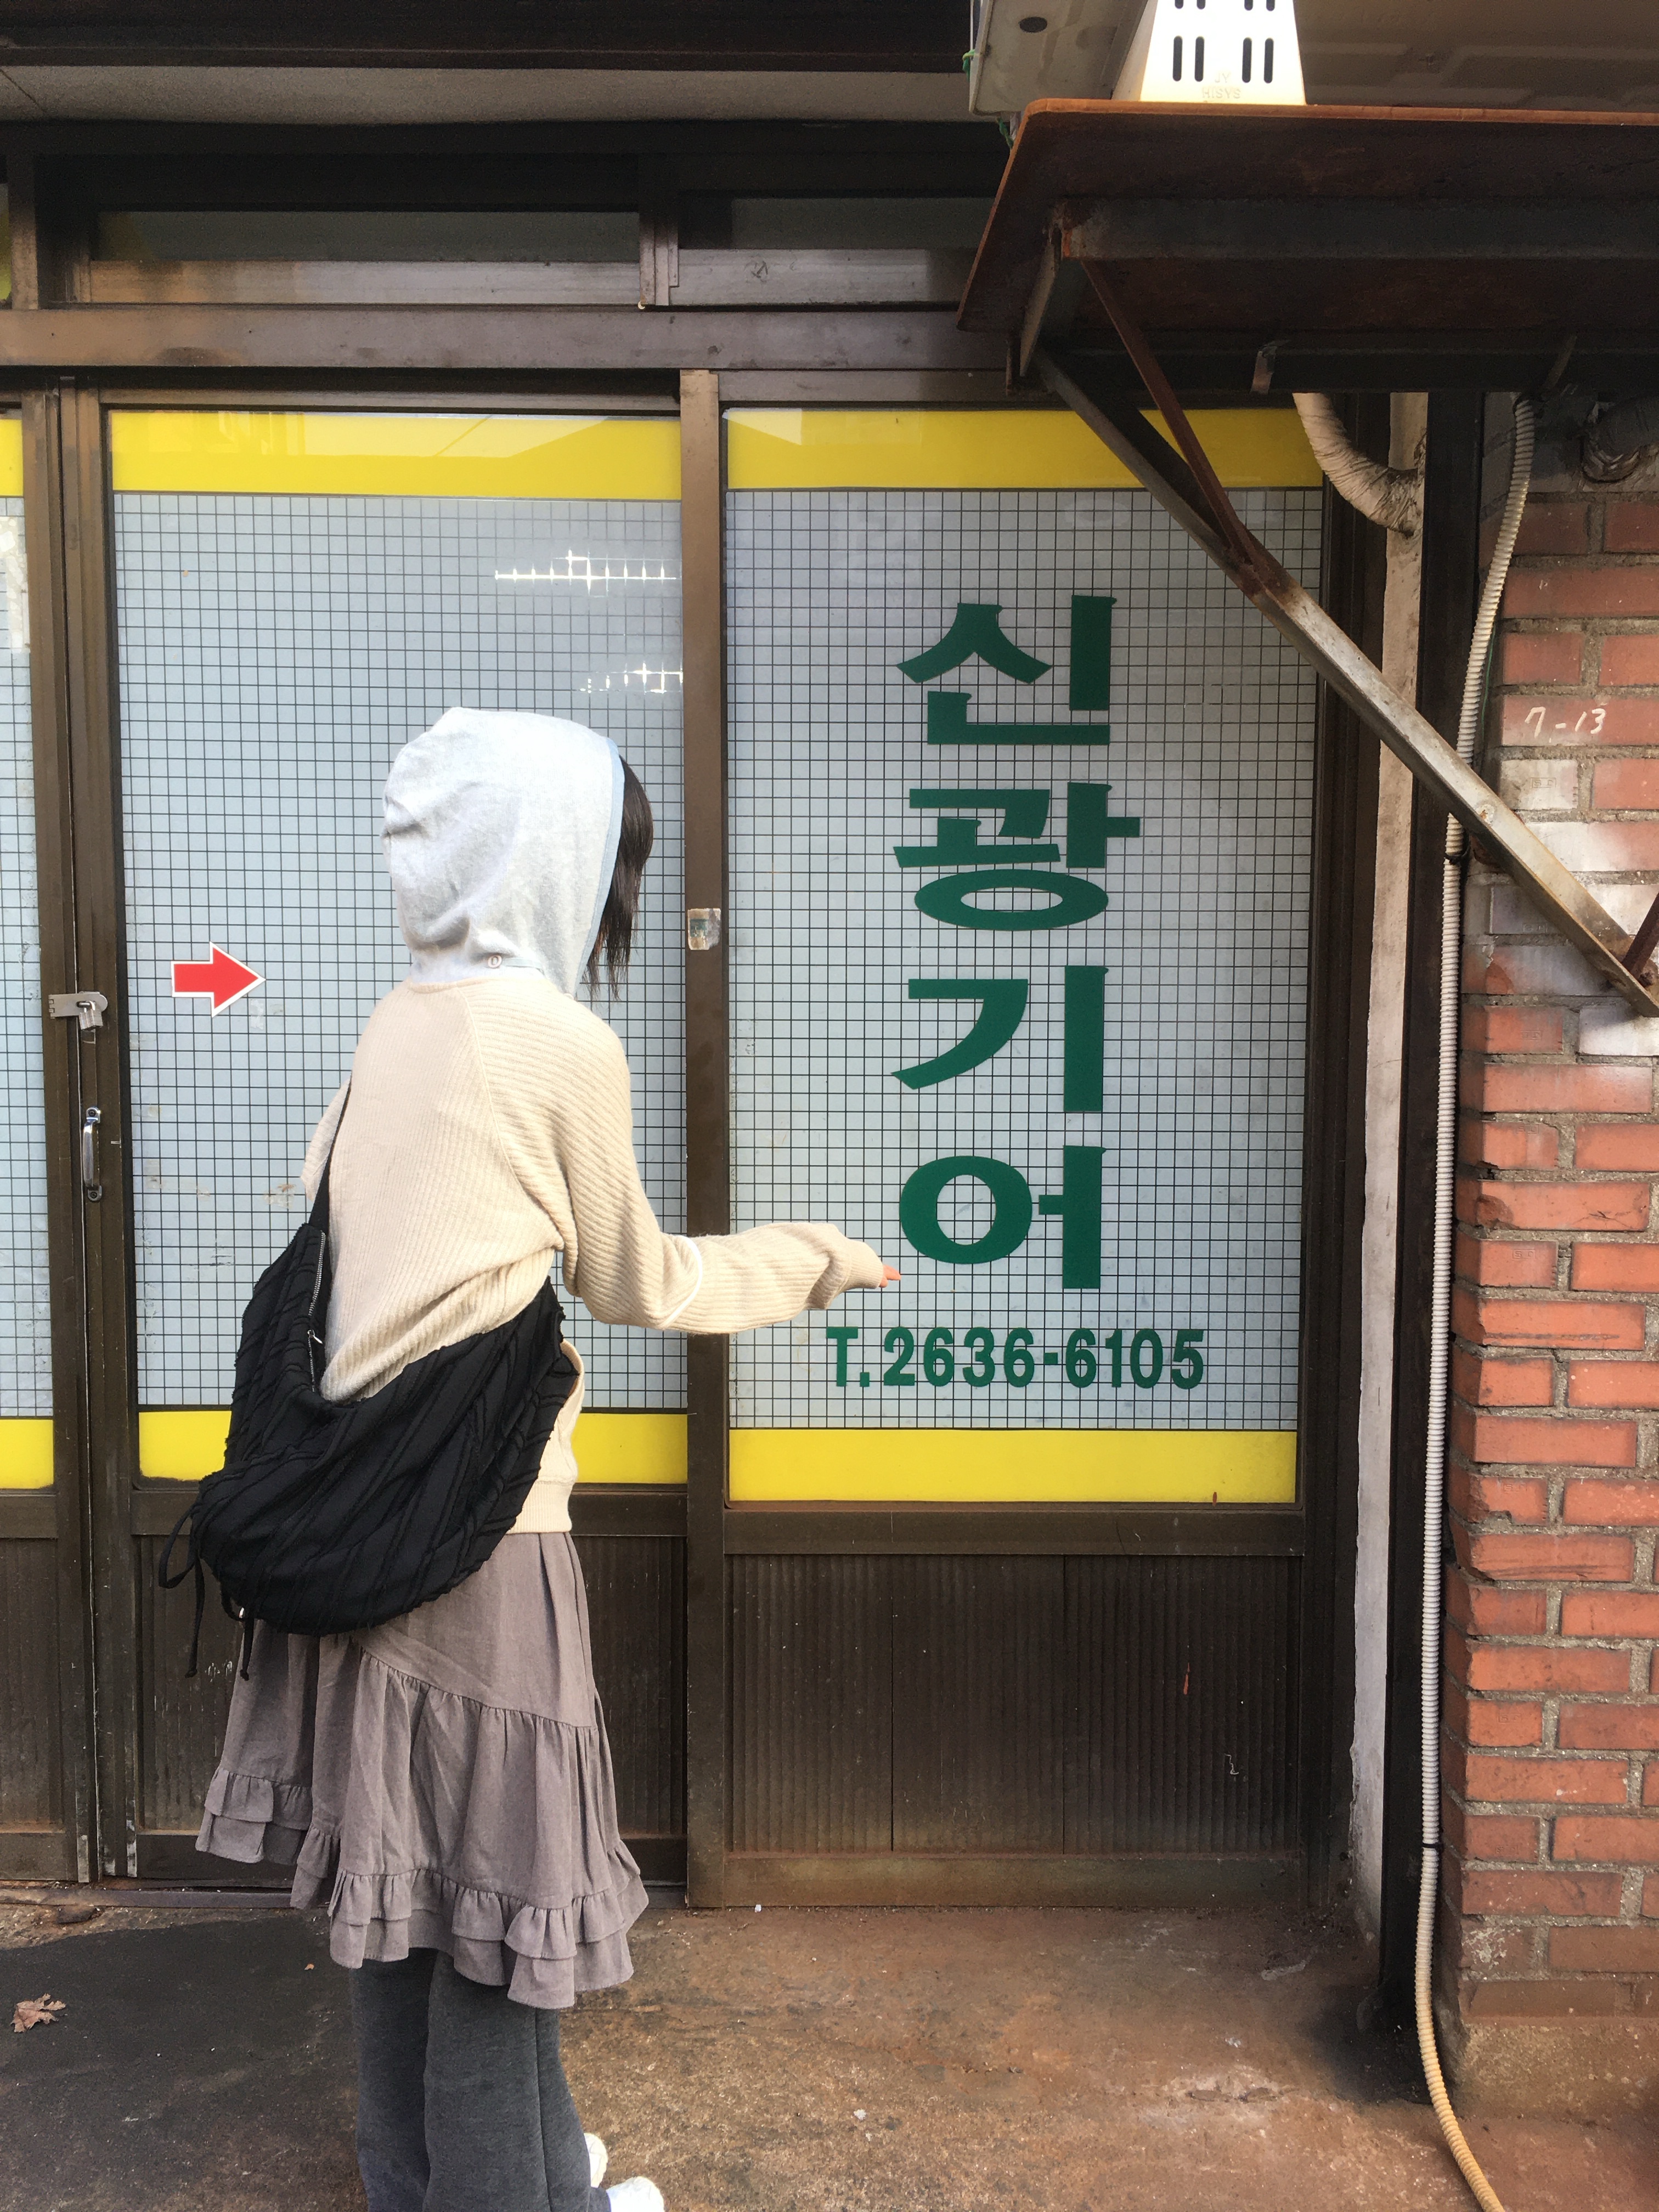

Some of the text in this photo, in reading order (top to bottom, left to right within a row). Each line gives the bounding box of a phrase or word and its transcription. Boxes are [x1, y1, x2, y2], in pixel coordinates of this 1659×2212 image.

[1203, 87, 1241, 99] HISYS
[1215, 73, 1230, 83] JY
[1525, 706, 1606, 738] 7-13
[893, 595, 1140, 1289] 신광기어
[826, 1327, 1204, 1389] T.2636-6105
